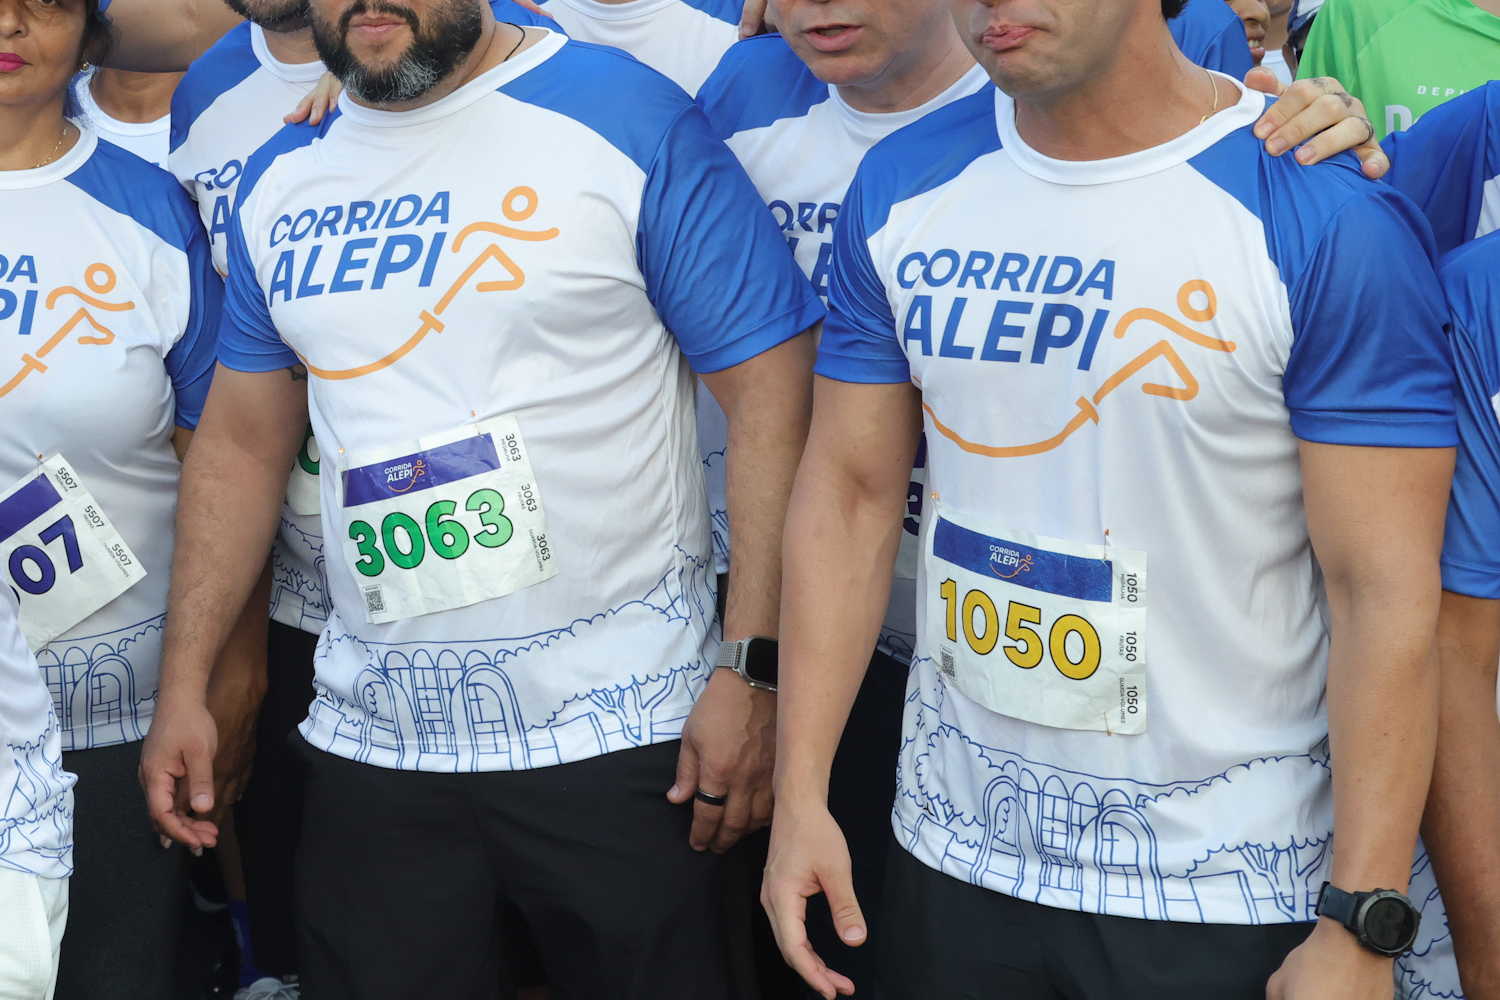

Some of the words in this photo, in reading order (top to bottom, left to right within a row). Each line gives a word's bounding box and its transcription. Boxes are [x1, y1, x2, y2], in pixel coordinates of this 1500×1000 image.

[270, 191, 450, 249] CORRIDA
[269, 232, 448, 308] ALEPI
[897, 249, 1115, 300] CORRIDA
[904, 295, 1110, 371] ALEPI
[505, 433, 521, 462] 3063
[57, 467, 78, 491] 5507
[384, 462, 412, 474] CORRIDA
[387, 469, 413, 483] ALEPI
[521, 483, 537, 512] 3063
[84, 505, 104, 529] 5507
[349, 488, 513, 577] 3063
[8, 514, 84, 605] 07
[111, 543, 132, 567] 5507
[536, 533, 551, 562] 3063
[989, 545, 1020, 558] CORRIDA
[990, 552, 1019, 567] ALEPI
[1126, 572, 1138, 603] 1050
[940, 577, 1101, 681] 1050
[1125, 630, 1137, 662] 1050
[1126, 685, 1138, 715] 1050
